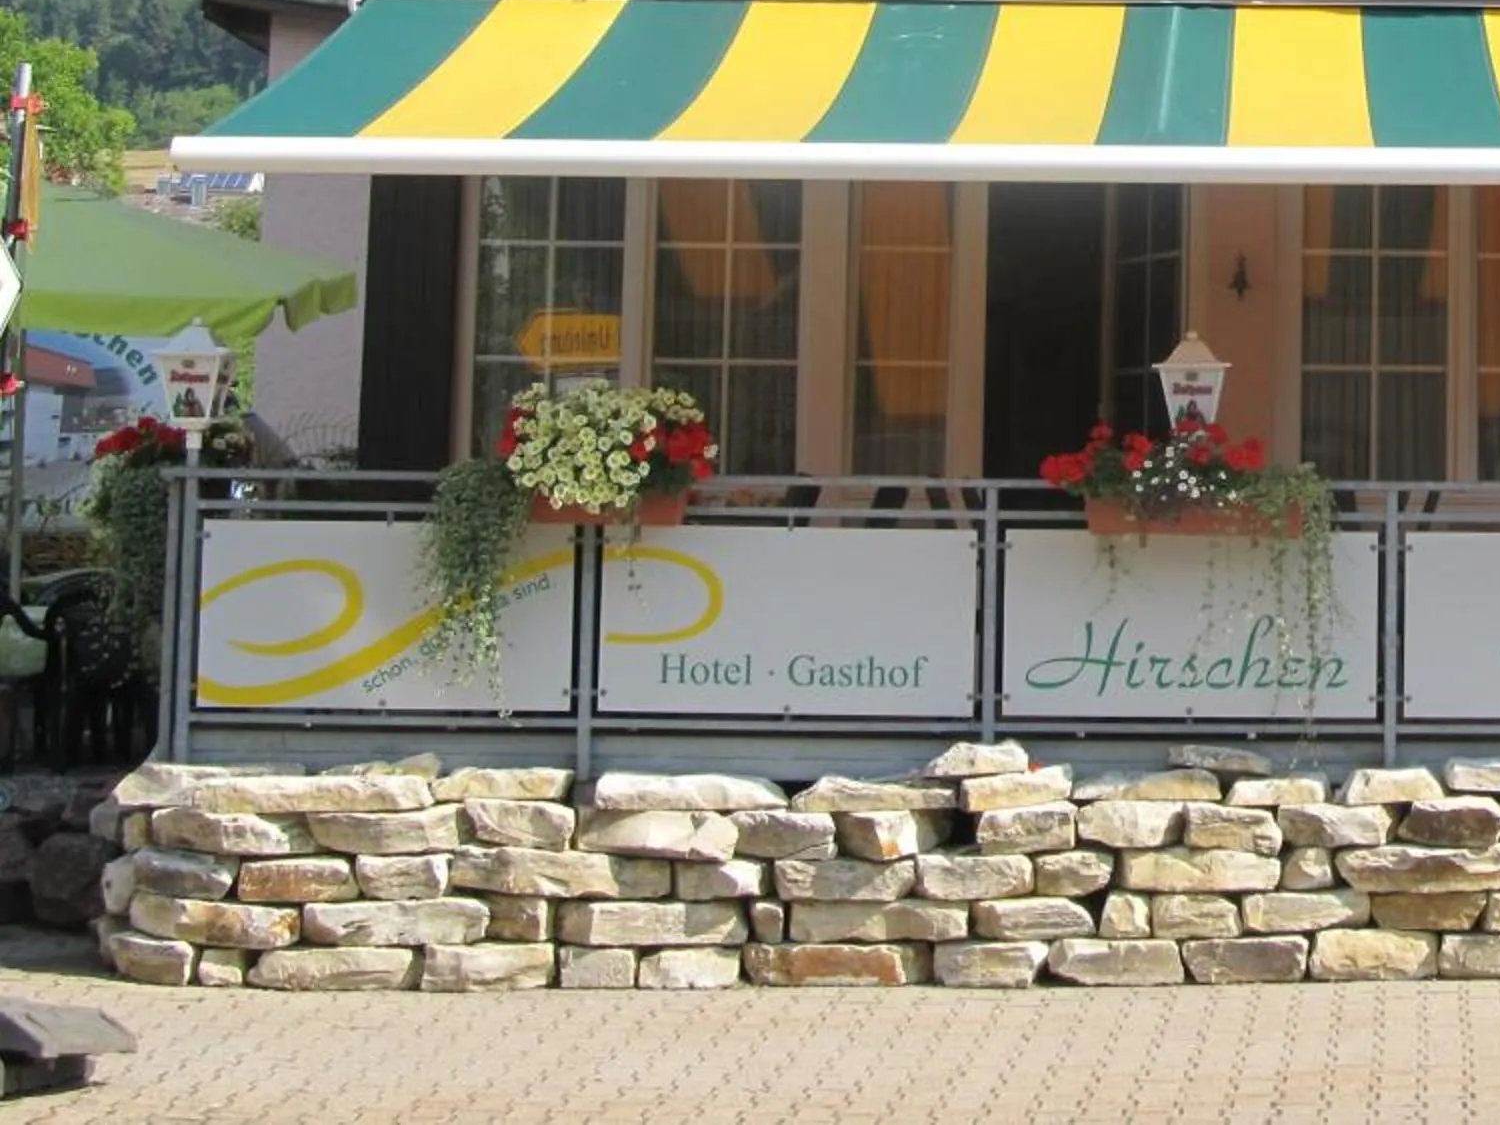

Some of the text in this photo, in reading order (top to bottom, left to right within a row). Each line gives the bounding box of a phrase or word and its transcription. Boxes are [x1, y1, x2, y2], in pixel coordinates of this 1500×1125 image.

[660, 653, 752, 685] Hotel
[787, 654, 929, 688] Gasthof
[1025, 614, 1349, 697] Hirschen
